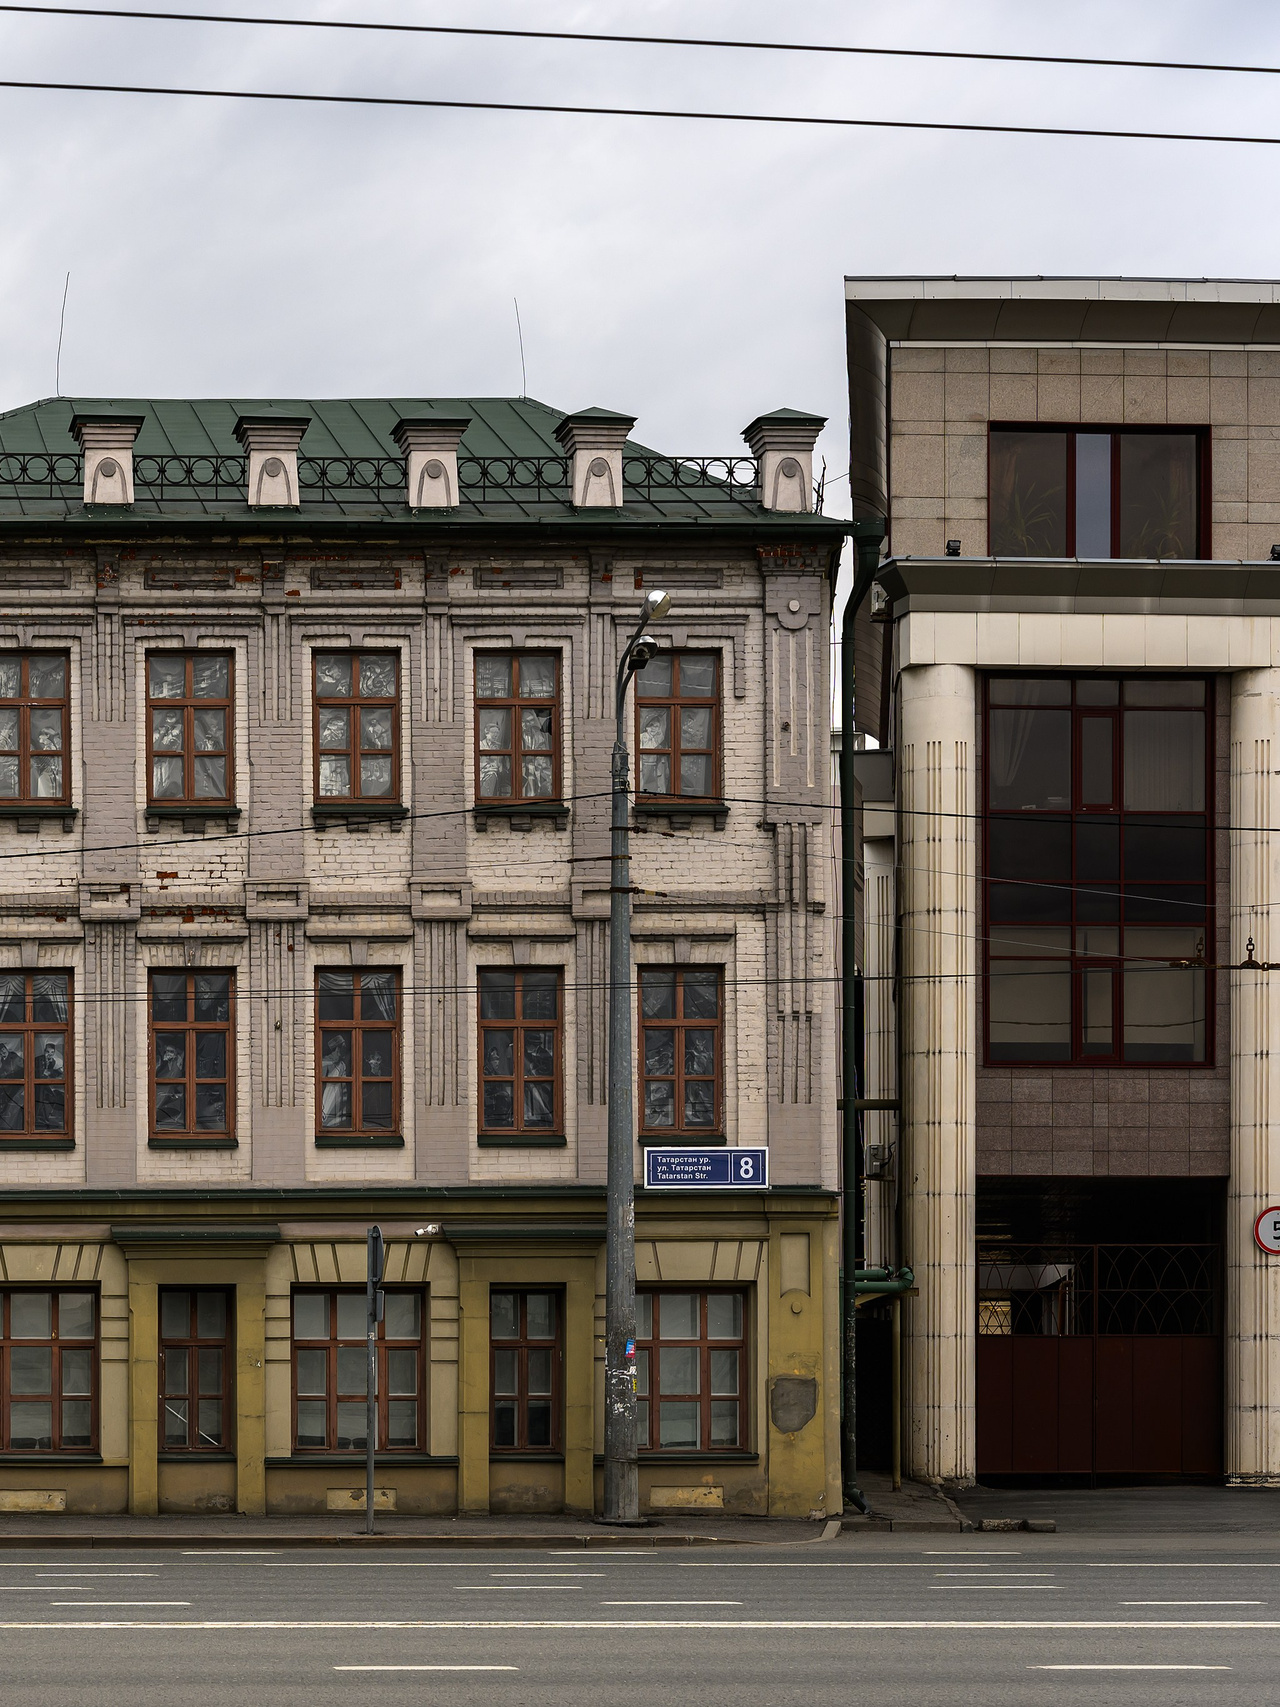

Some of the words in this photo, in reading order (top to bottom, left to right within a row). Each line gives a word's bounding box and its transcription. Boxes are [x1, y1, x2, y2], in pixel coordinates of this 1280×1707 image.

[657, 1156, 697, 1164] Татарстан
[671, 1164, 712, 1172] Татарстан
[739, 1156, 754, 1179] 8
